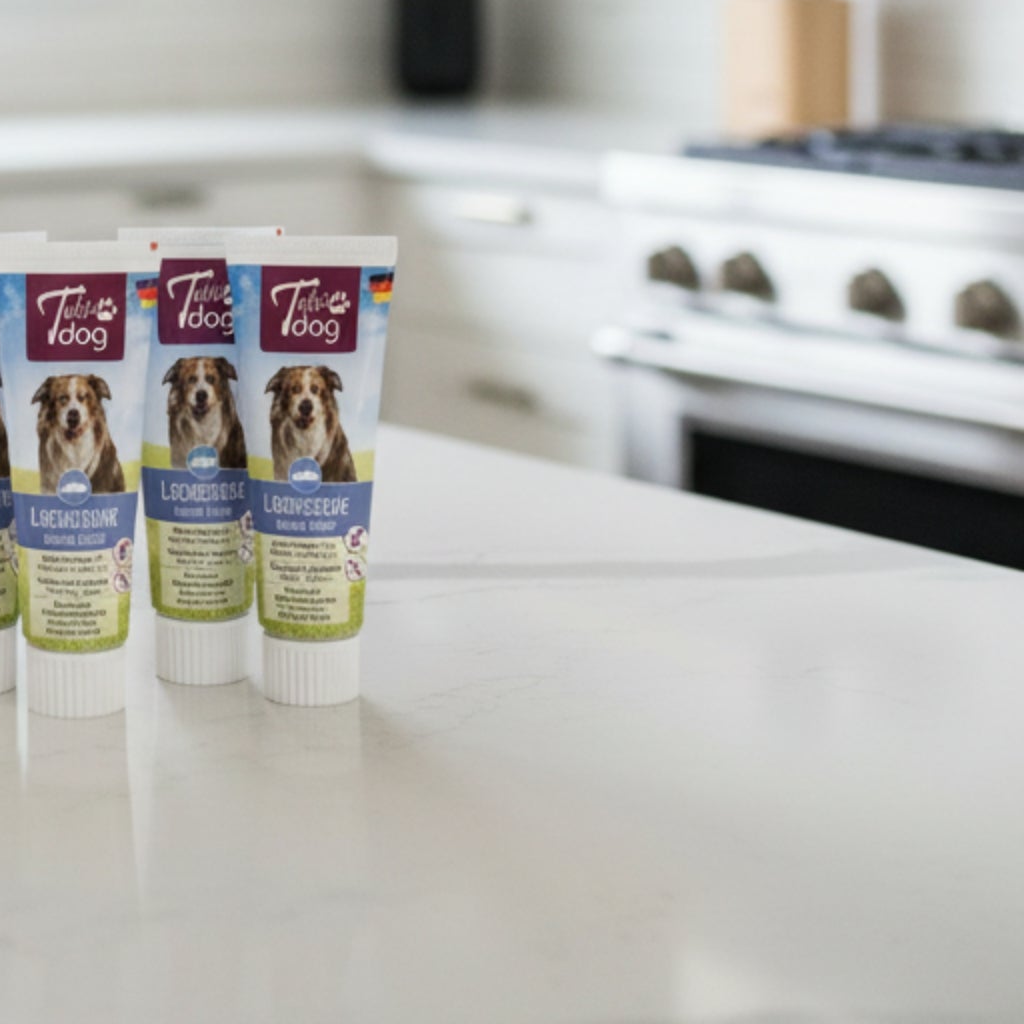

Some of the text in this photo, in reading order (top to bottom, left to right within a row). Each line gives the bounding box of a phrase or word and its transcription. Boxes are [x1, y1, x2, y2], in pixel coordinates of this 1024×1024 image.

[188, 304, 234, 336] dog
[291, 312, 340, 344] dog
[58, 321, 108, 352] dog
